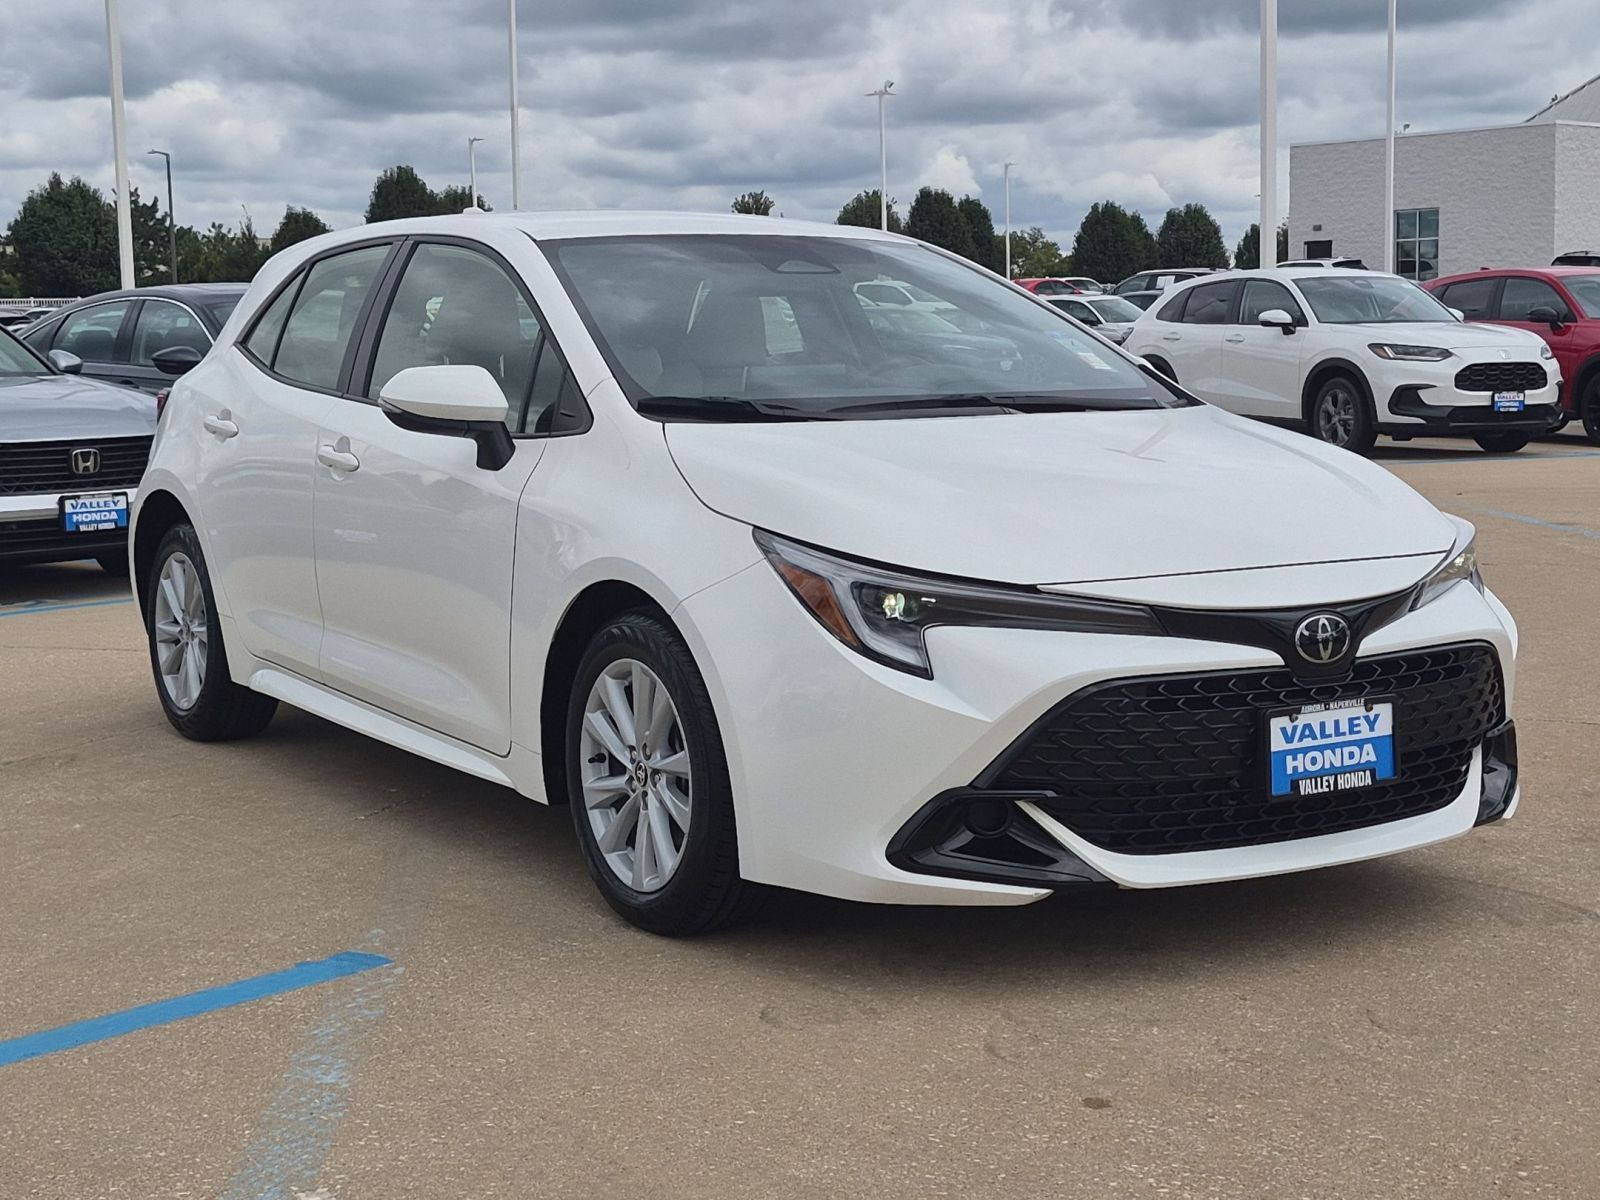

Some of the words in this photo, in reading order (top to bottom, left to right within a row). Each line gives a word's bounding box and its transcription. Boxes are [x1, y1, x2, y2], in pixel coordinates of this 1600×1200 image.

[70, 500, 120, 510] VALLEY
[72, 511, 118, 522] HONDA
[1329, 698, 1365, 710] NAPERVILLE
[1280, 713, 1380, 744] VALLEY
[1286, 743, 1377, 775] HONDA
[1299, 776, 1335, 795] VALLEY
[1337, 770, 1372, 790] HONDA
